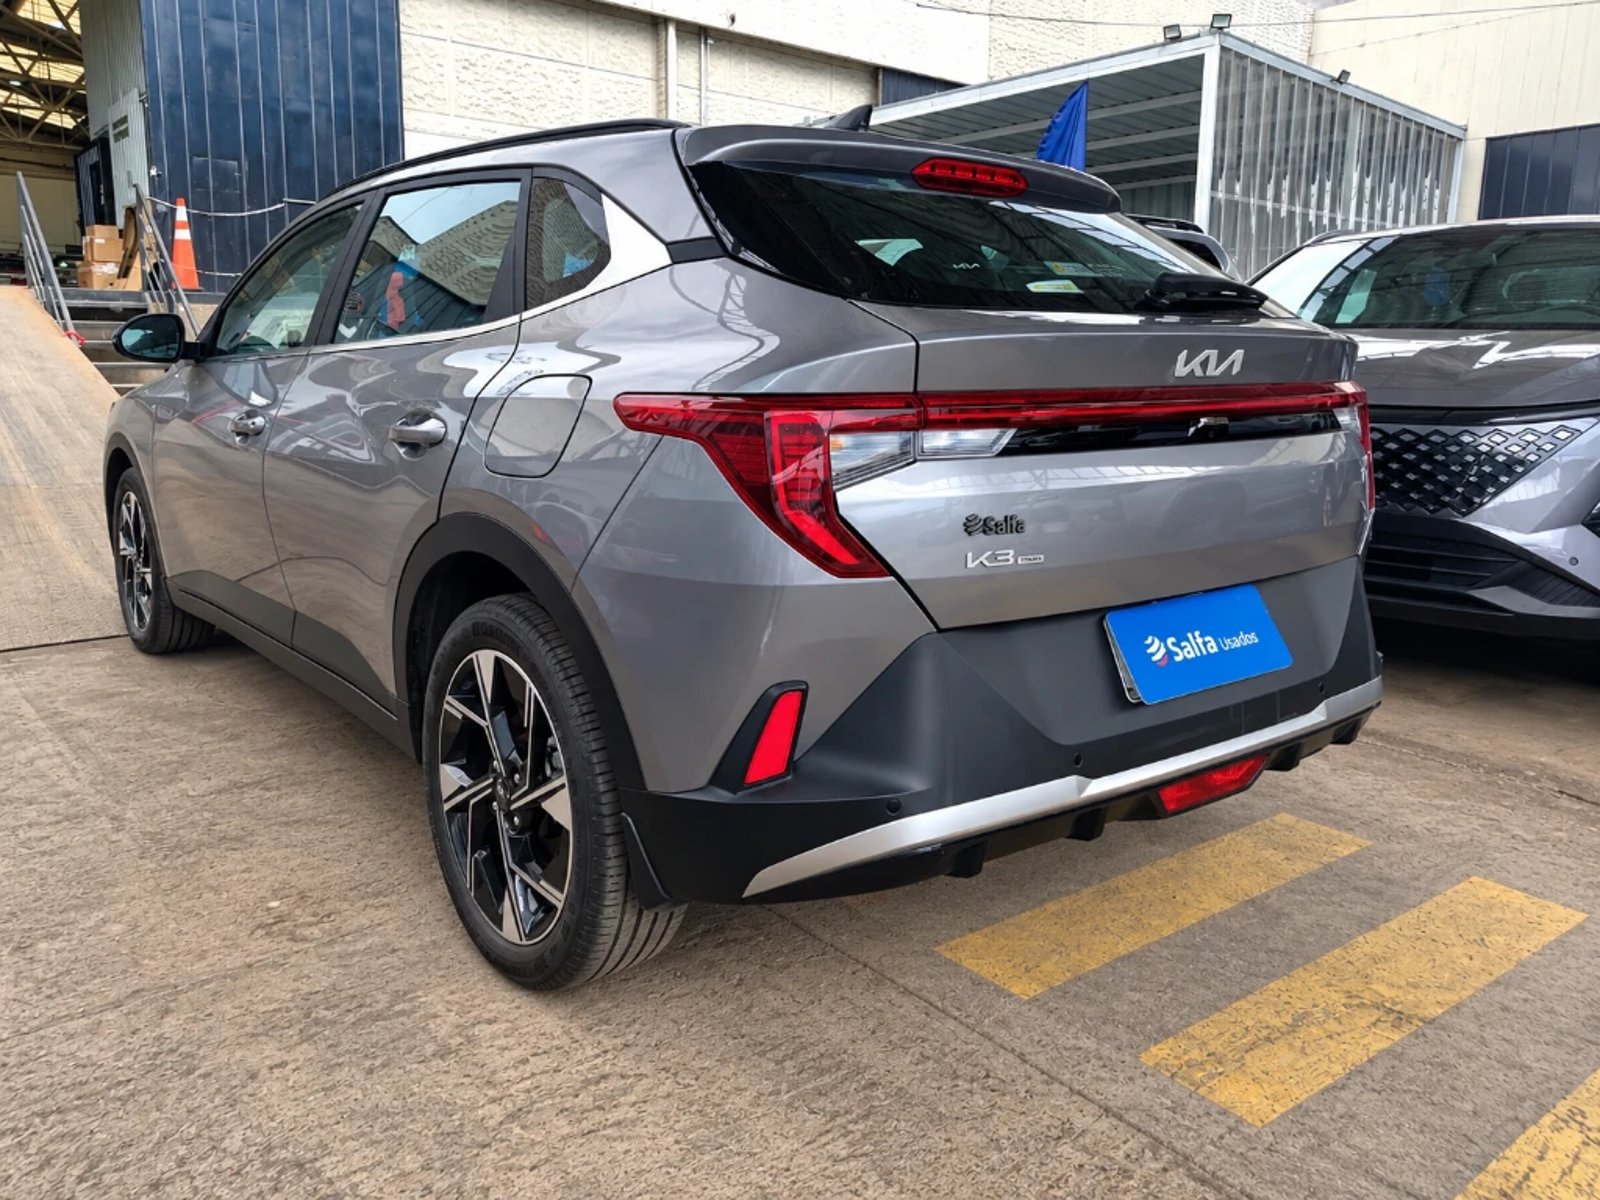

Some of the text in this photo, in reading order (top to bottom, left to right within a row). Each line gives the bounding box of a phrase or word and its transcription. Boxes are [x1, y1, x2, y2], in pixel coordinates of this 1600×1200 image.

[1174, 349, 1245, 377] KIA
[982, 514, 1025, 536] Salfa
[966, 549, 1015, 568] K3
[1166, 630, 1259, 662] Salfa Usados
